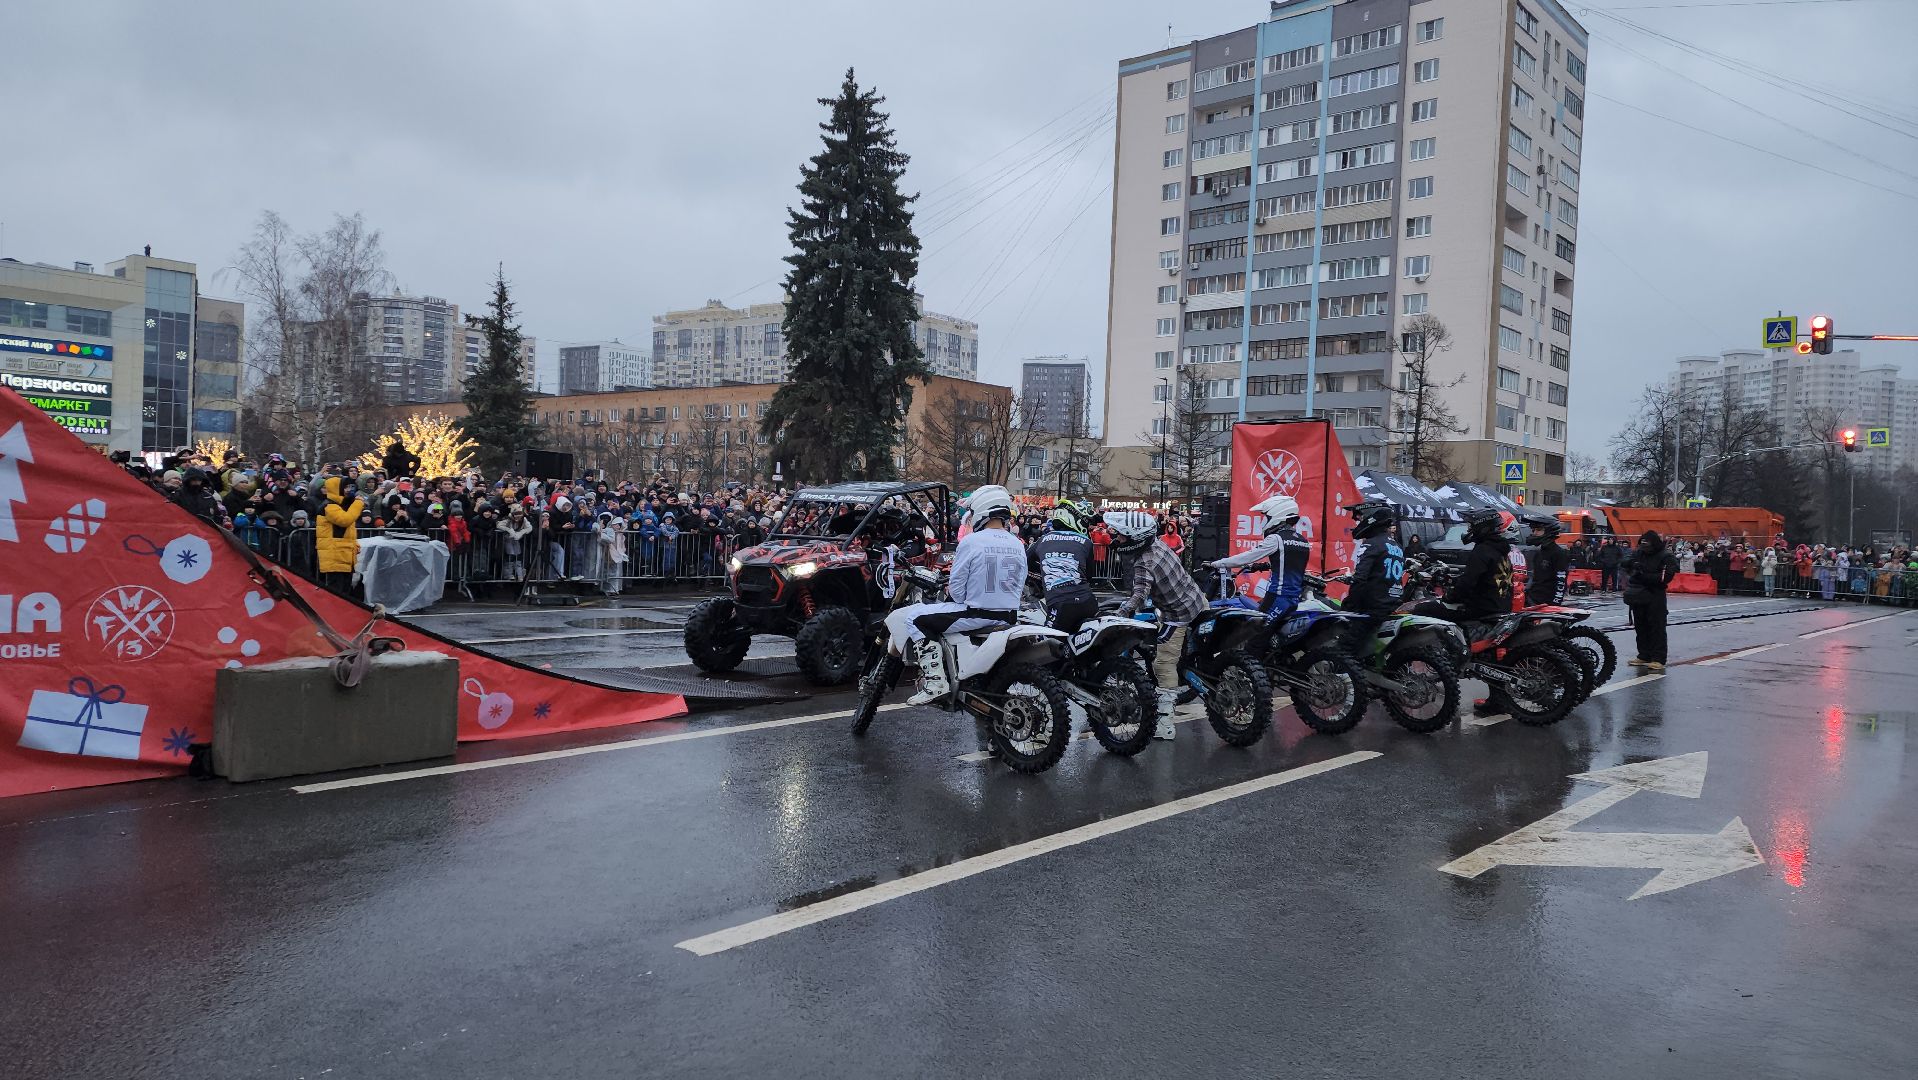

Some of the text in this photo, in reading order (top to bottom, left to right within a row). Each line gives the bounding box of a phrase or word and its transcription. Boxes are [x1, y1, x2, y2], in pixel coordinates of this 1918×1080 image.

[31, 341, 54, 352] мир
[0, 373, 108, 394] Перекресток
[26, 397, 92, 411] РМАРКЕТ
[49, 416, 108, 428] ODENT
[1236, 514, 1314, 538] ЗИА
[985, 554, 1022, 593] 13
[0, 592, 61, 633] А
[0, 642, 61, 659] ОВЬЕ
